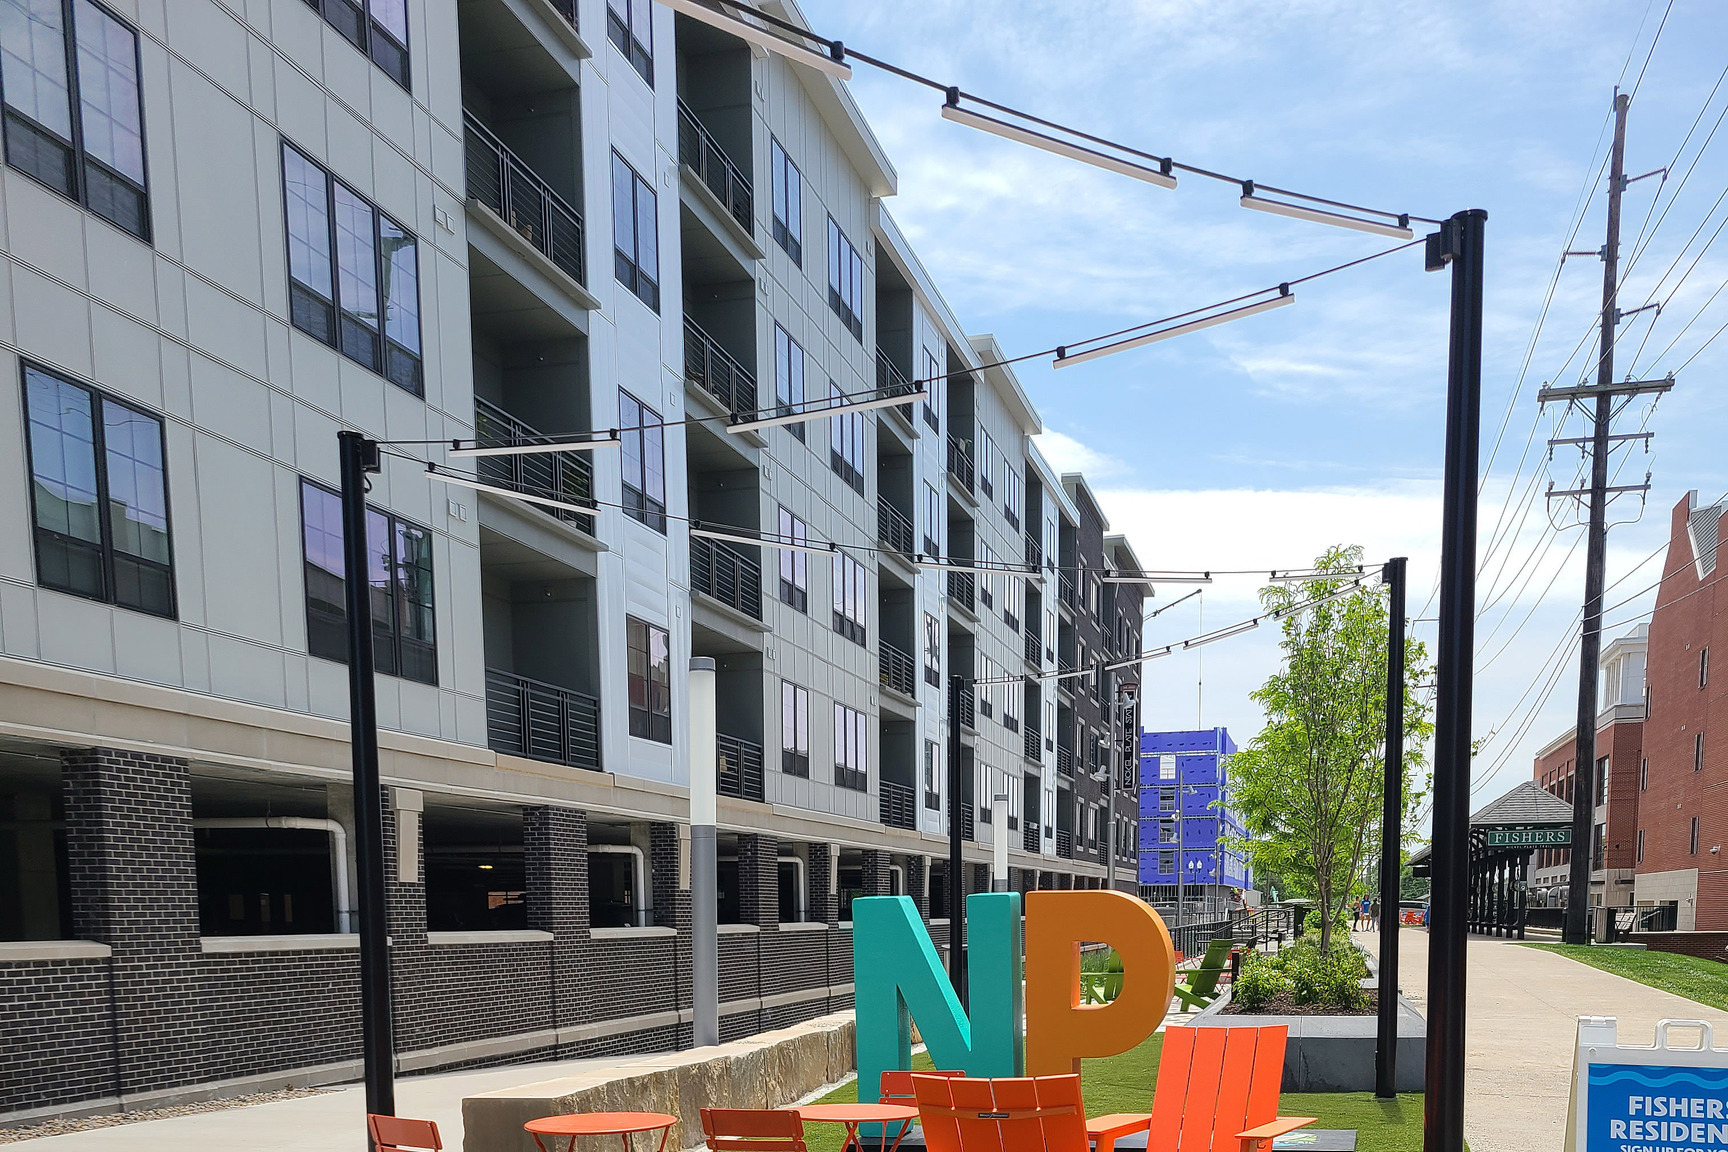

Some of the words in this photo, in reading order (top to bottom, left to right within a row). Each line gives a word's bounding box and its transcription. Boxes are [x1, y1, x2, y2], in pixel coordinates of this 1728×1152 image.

[1125, 727, 1133, 753] PLATE
[1494, 831, 1566, 844] FISHERS
[1628, 1095, 1728, 1120] FISHER
